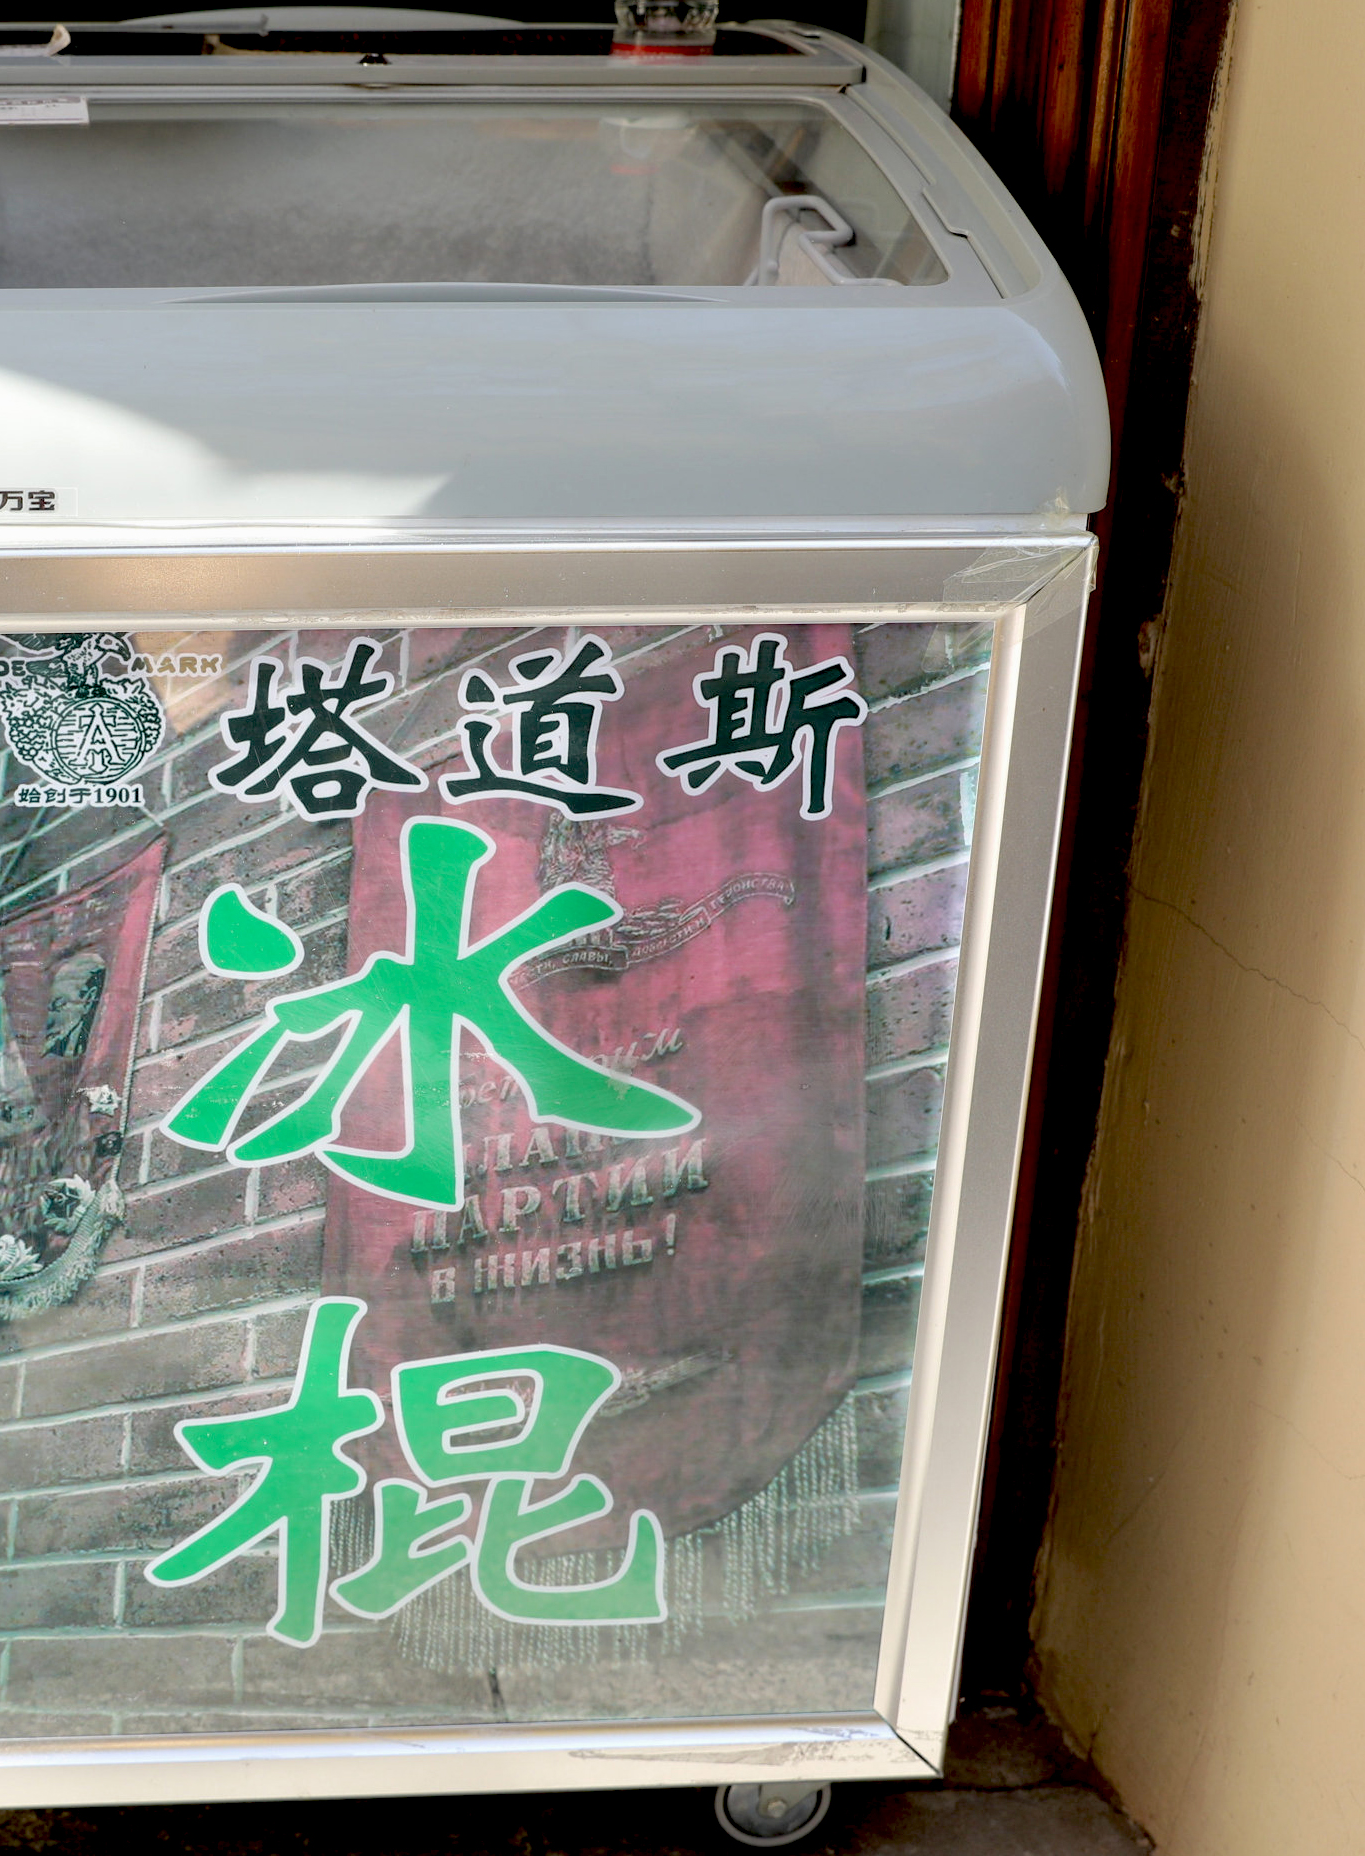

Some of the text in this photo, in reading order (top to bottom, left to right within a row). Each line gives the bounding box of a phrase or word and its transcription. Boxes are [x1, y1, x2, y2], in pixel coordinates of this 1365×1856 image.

[132, 655, 223, 675] MARK
[213, 637, 864, 816] 塔道斯
[146, 817, 699, 1646] 冰棍
[410, 1137, 709, 1253] ПАРТИИ
